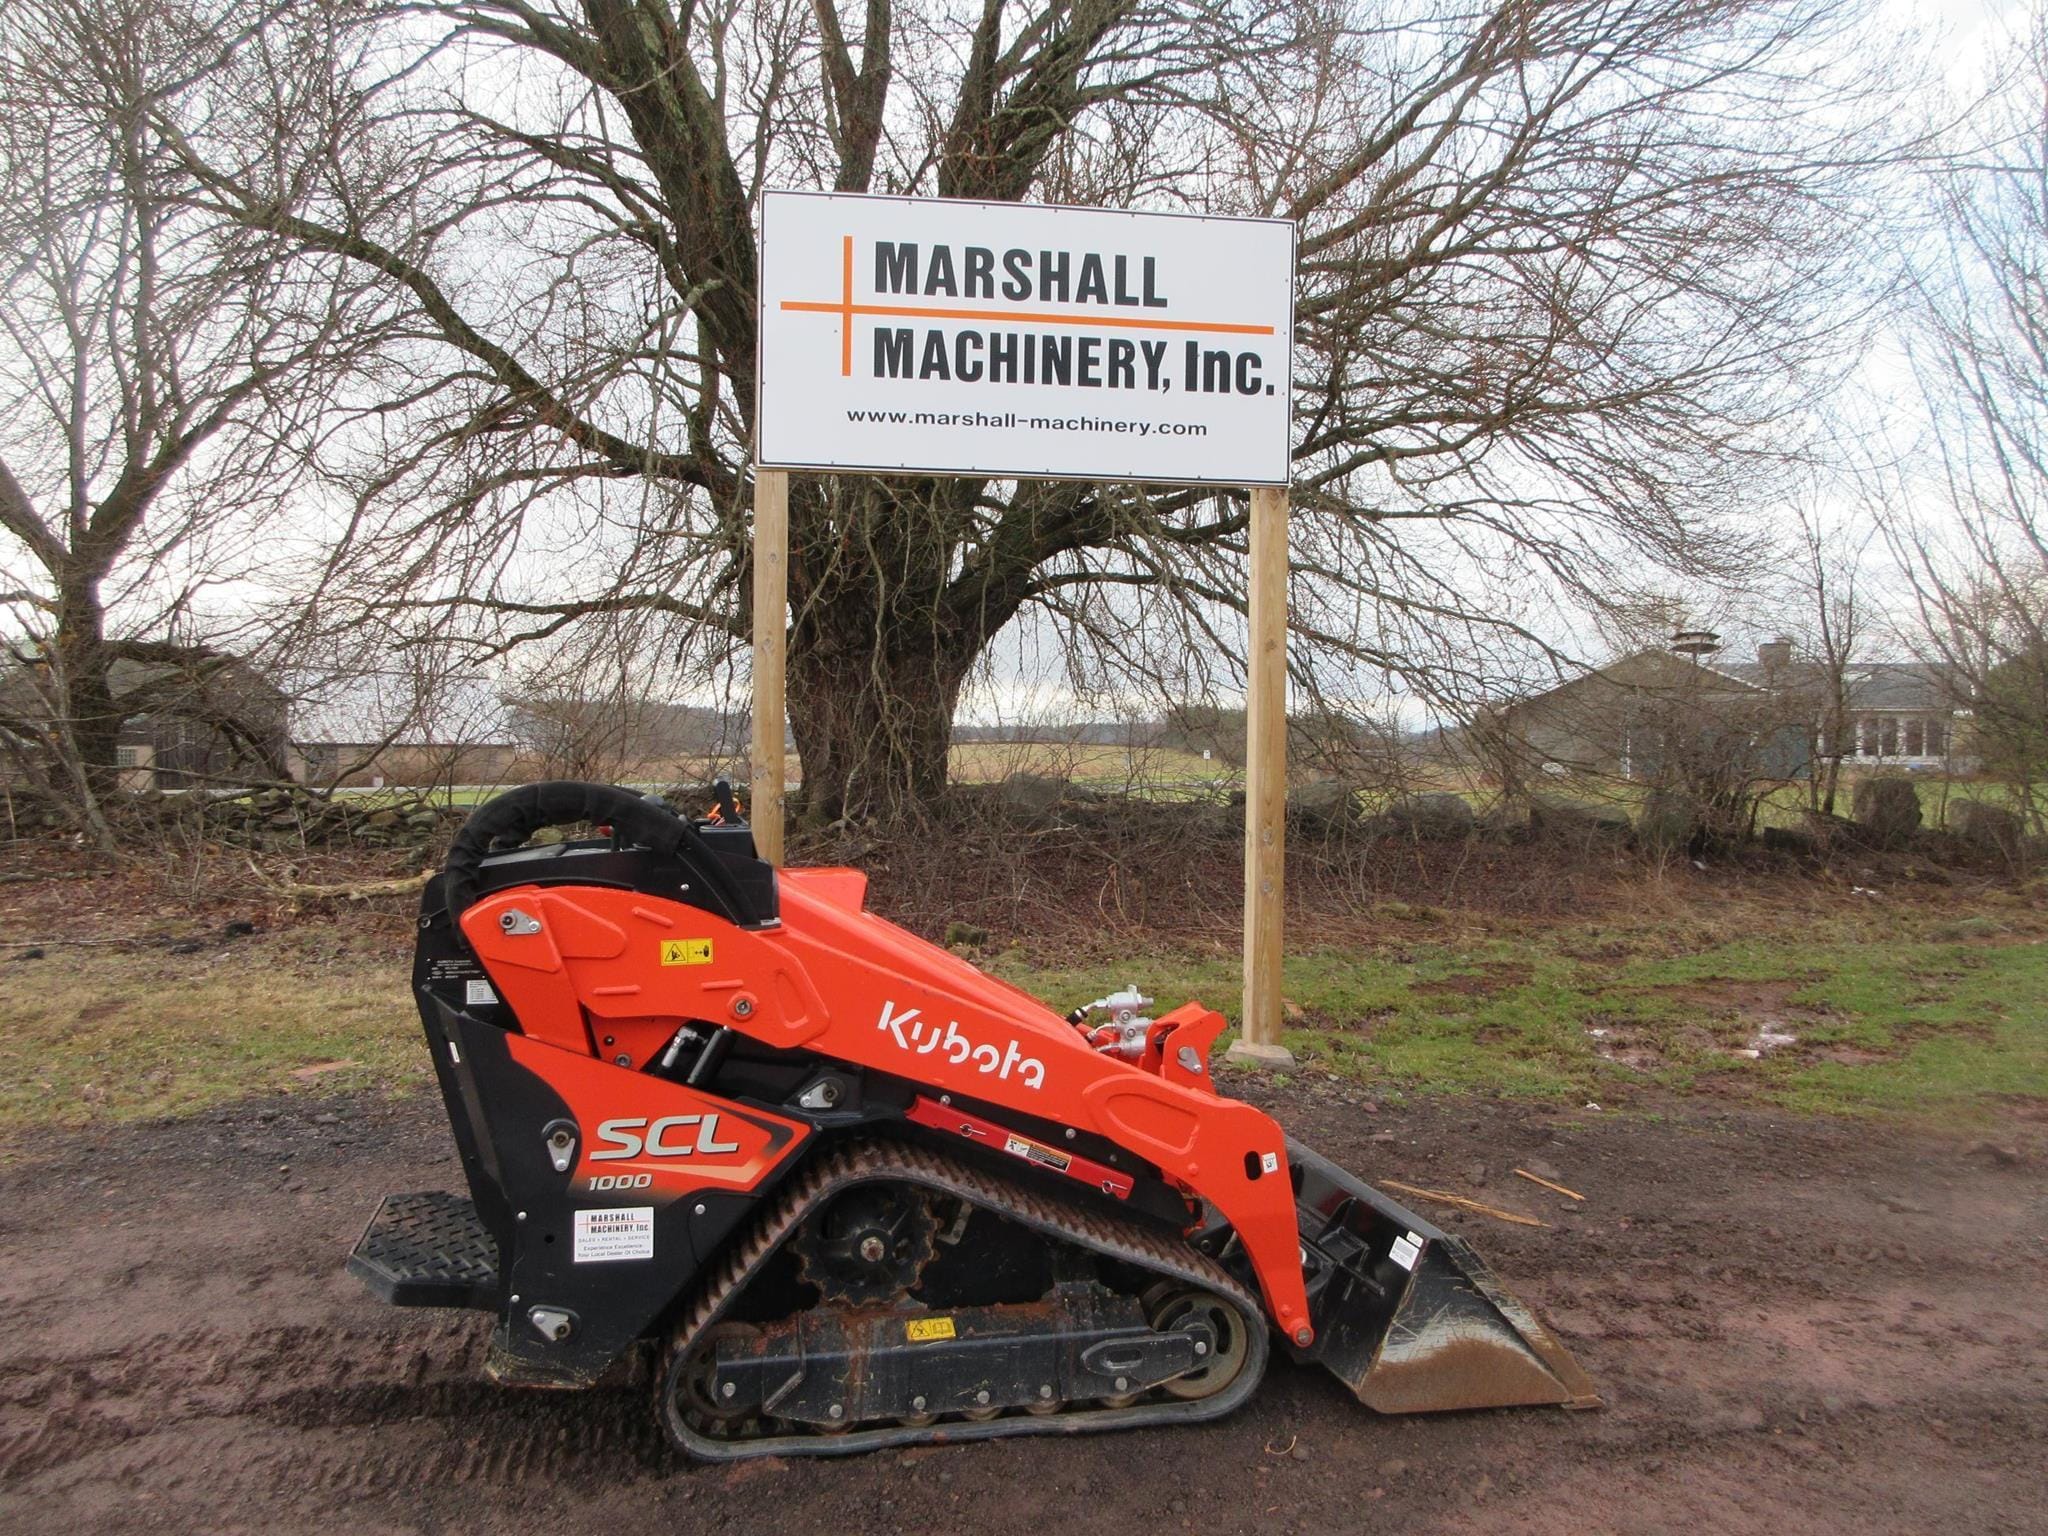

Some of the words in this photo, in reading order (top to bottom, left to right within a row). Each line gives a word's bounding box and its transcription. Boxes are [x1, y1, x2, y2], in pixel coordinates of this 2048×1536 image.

[874, 241, 1168, 308] MARSHALL
[873, 327, 1170, 395] MACHINERY,
[1184, 341, 1275, 396] Inc.
[846, 409, 1208, 437] www.marshall-machinery.com
[877, 1000, 1045, 1089] Kubota
[589, 1114, 739, 1160] SCL
[588, 1173, 653, 1191] 1000
[590, 1213, 635, 1222] MARSHALL
